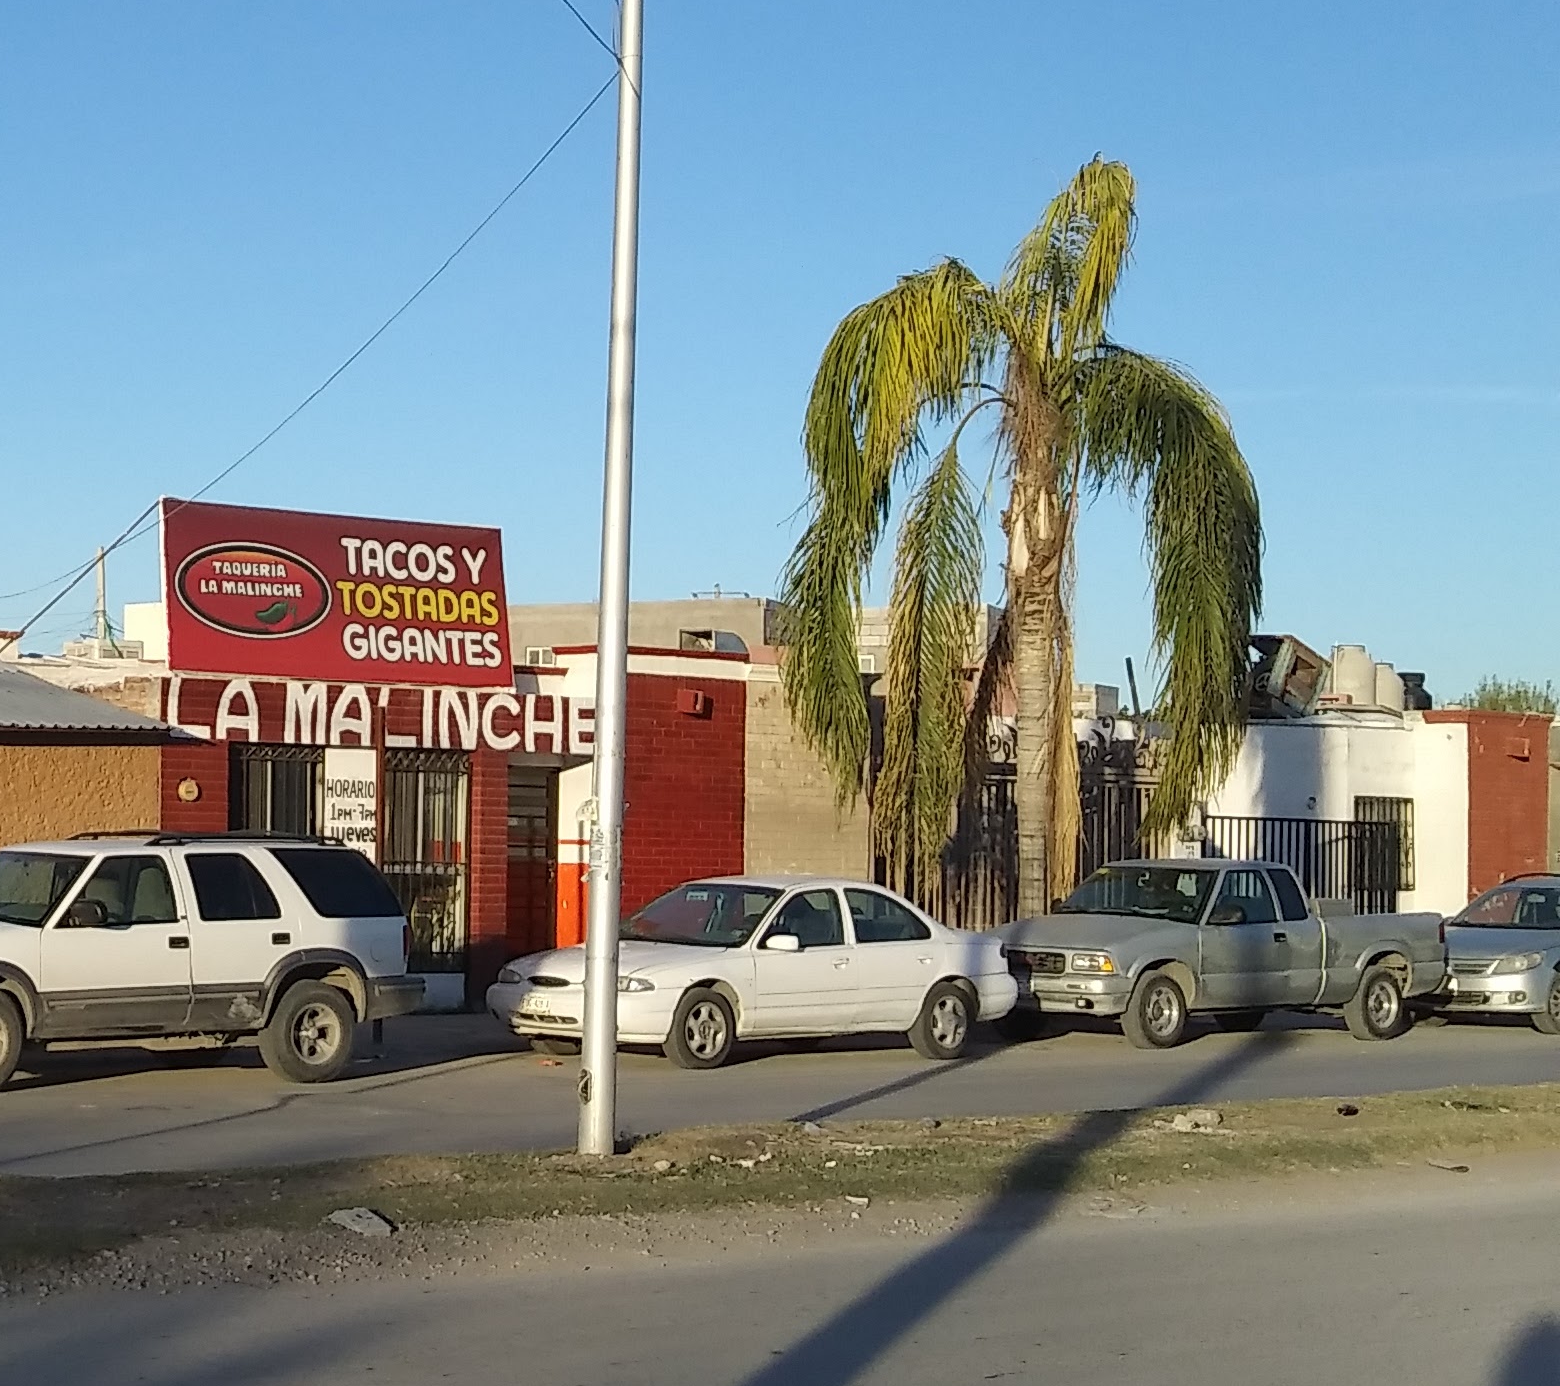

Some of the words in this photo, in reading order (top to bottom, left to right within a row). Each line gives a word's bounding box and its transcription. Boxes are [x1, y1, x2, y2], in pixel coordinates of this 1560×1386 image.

[340, 537, 456, 584] TACOS
[461, 547, 487, 585] Y
[200, 579, 218, 593] LA
[221, 580, 303, 598] MALINCHE
[335, 580, 499, 626] TOSTADAS
[342, 623, 503, 668] GIGANTES
[167, 677, 259, 743] LA
[326, 779, 375, 798] HORARIO
